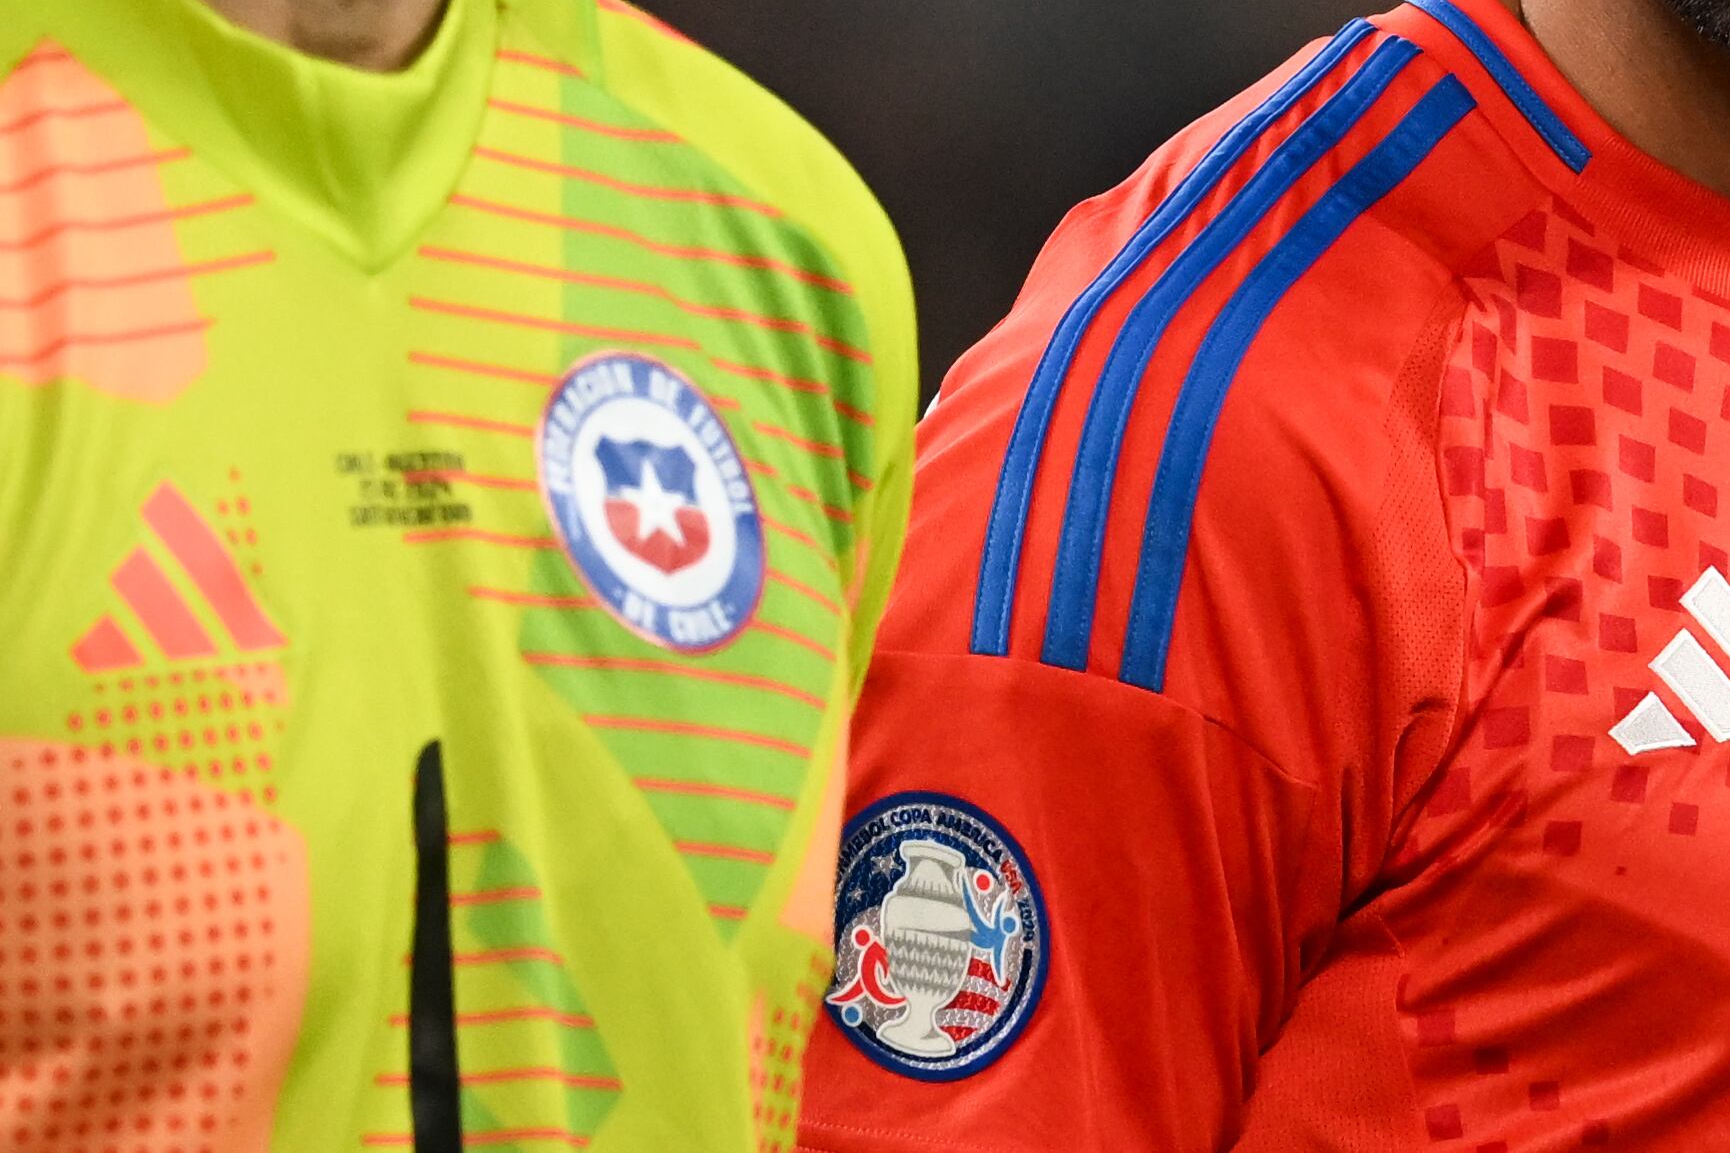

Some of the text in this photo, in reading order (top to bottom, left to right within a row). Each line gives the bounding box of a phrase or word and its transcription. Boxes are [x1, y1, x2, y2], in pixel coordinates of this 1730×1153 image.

[890, 808, 932, 827] COPA
[936, 812, 1003, 863] AMERICA
[1001, 859, 1023, 895] USA
